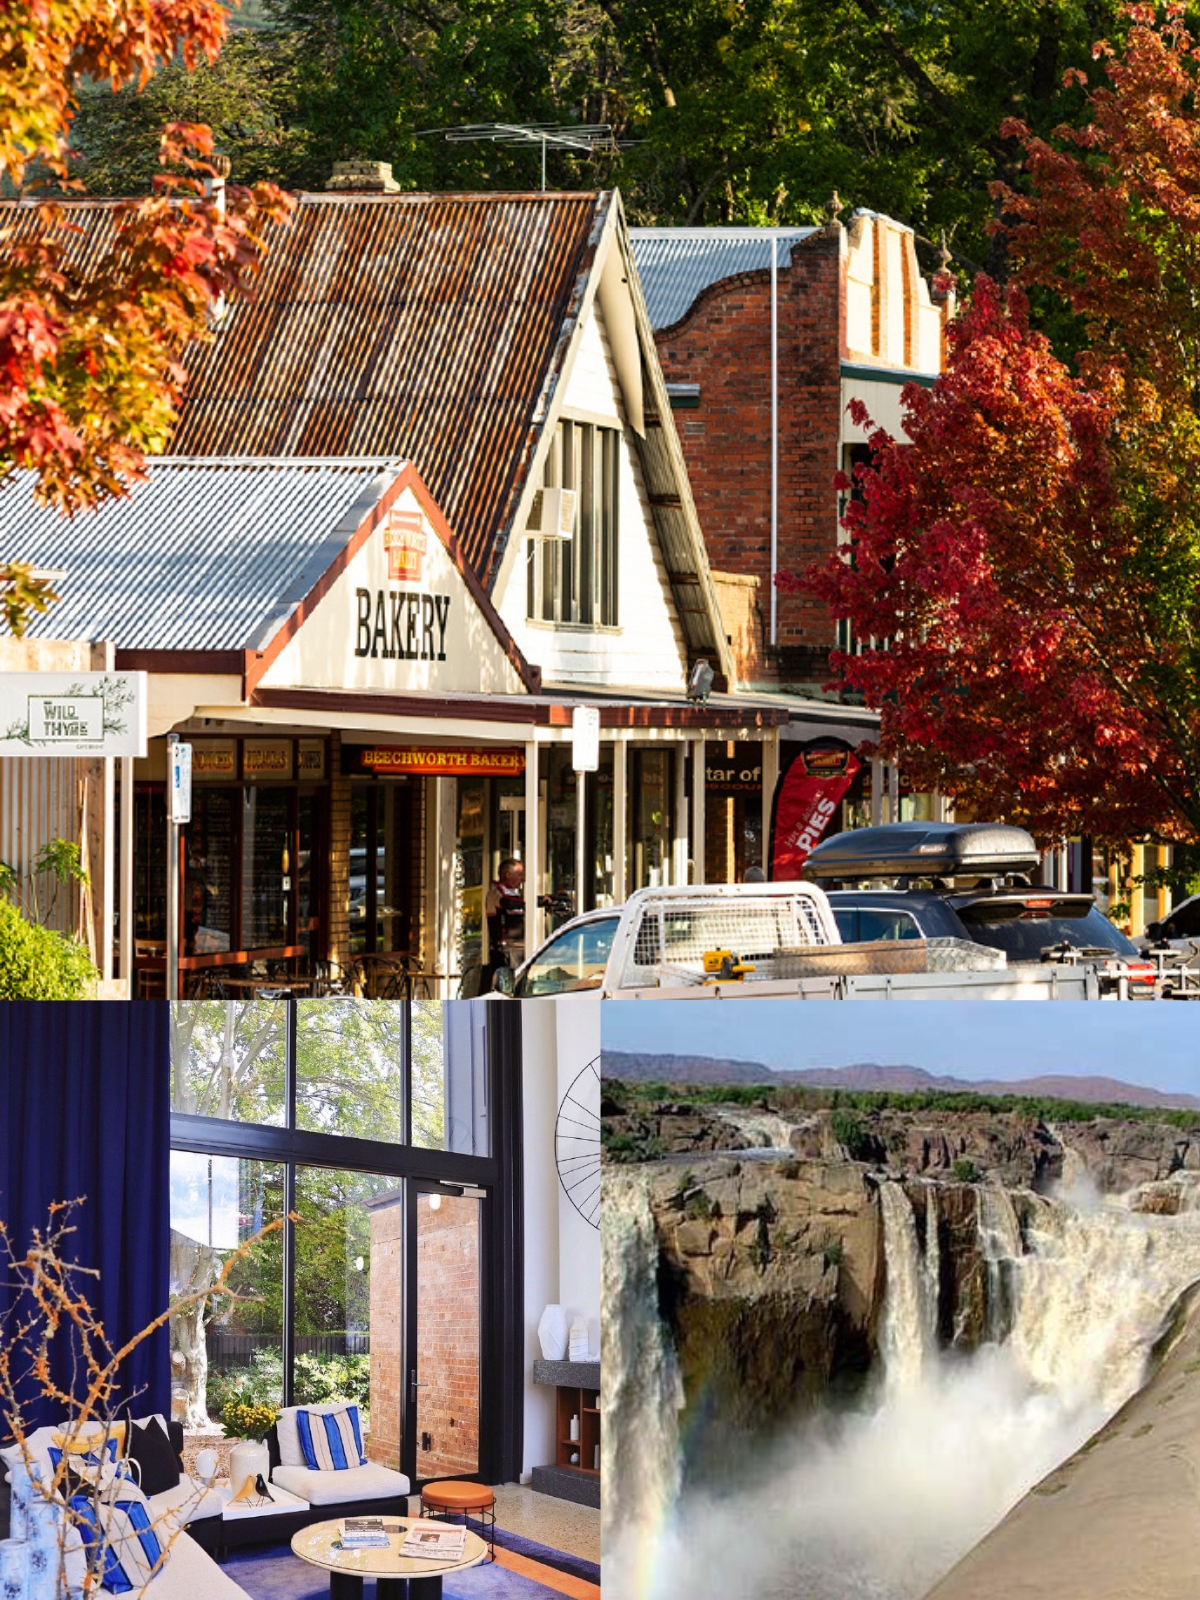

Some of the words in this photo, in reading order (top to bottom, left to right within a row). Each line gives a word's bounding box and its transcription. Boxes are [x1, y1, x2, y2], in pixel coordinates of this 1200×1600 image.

[354, 587, 451, 661] BAKERY
[43, 705, 79, 720] WILD
[43, 721, 88, 736] THYME
[364, 750, 467, 766] BEECHWORTH
[705, 766, 735, 781] tar
[739, 766, 762, 781] of
[795, 797, 837, 856] PIES
